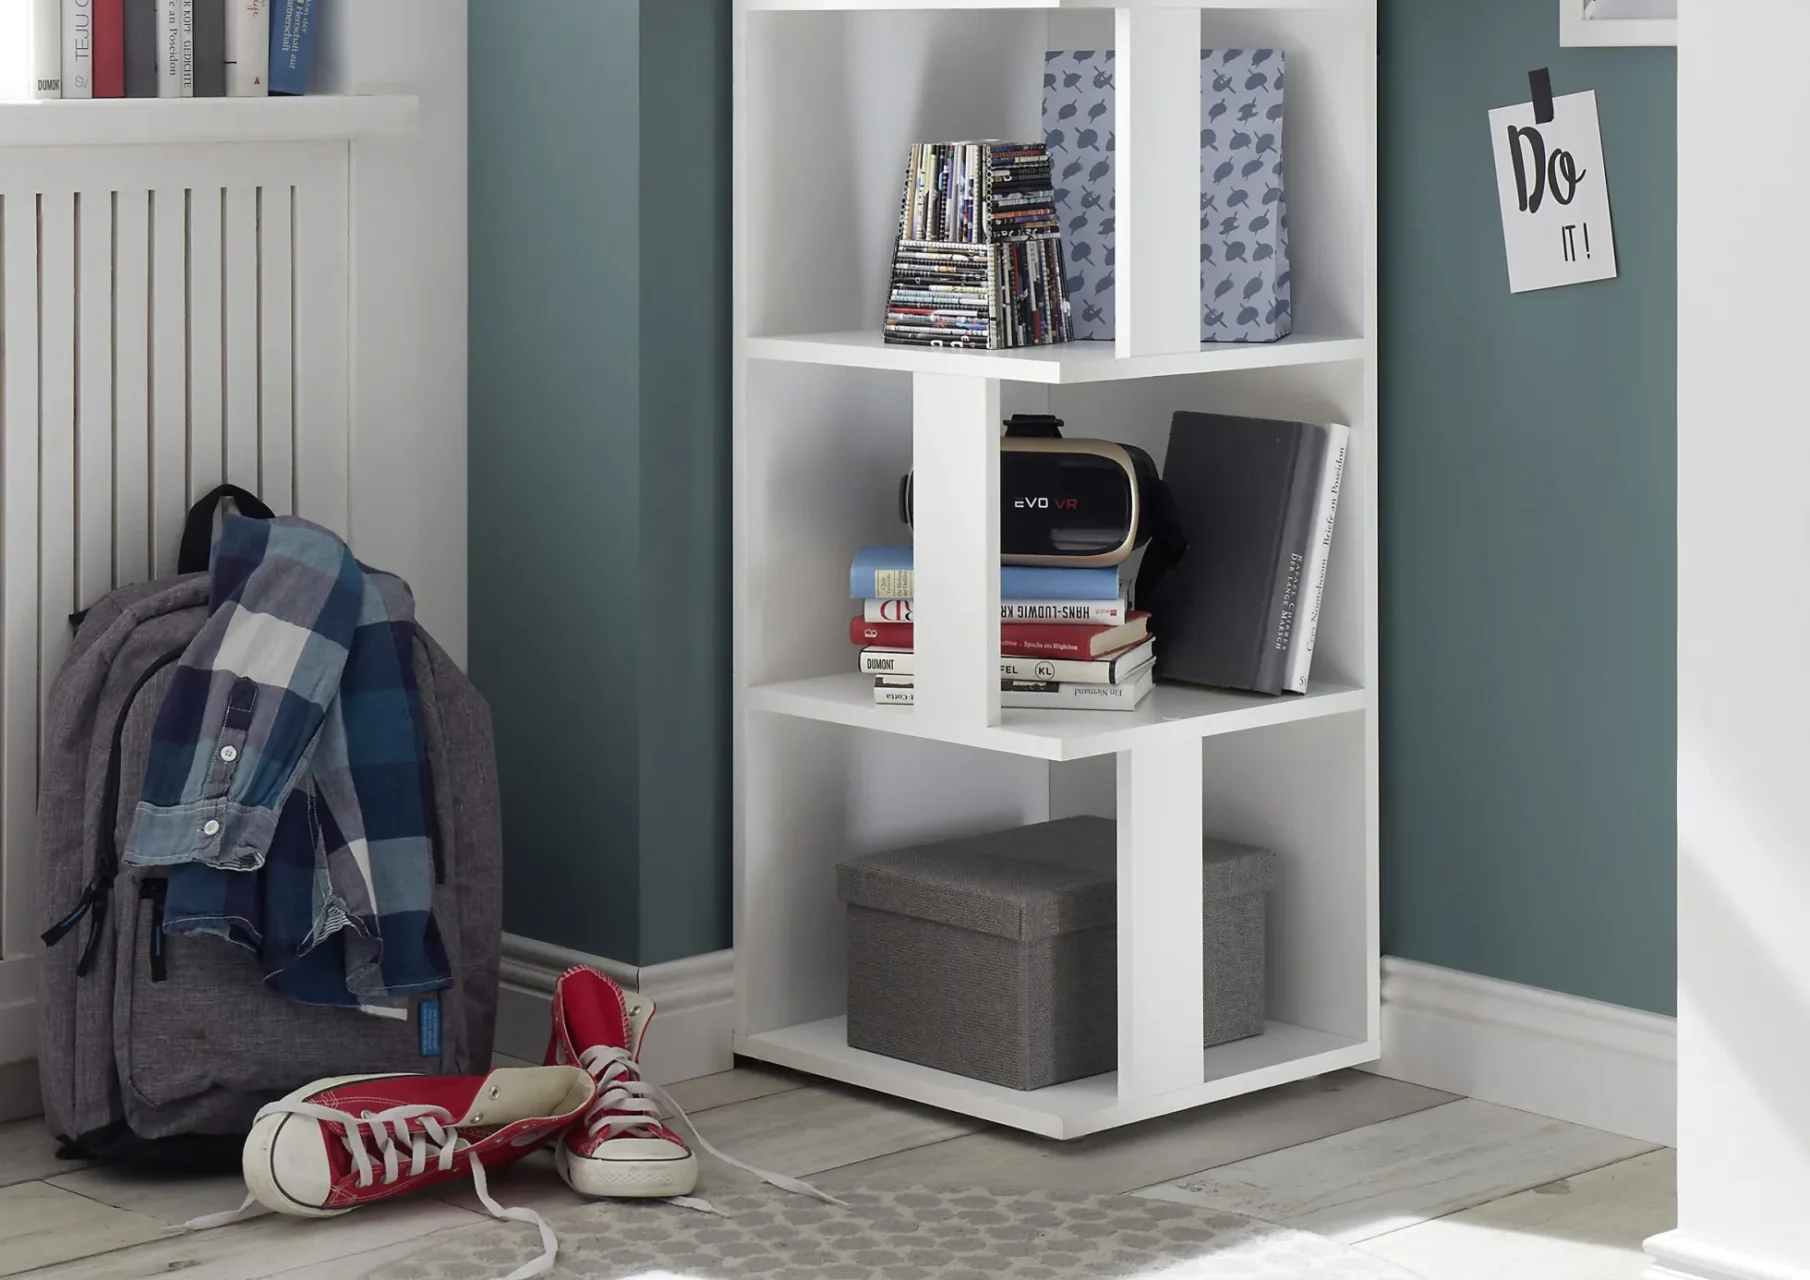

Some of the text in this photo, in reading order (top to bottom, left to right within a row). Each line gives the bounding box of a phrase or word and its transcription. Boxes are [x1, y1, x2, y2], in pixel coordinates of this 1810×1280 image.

[168, 10, 175, 24] an
[183, 10, 192, 34] KOPF
[75, 14, 89, 62] TEJU
[169, 28, 178, 76] Poseidon
[183, 40, 192, 89] GEDICHTE
[1507, 125, 1587, 214] Do
[1330, 447, 1345, 494] Poseidon
[1054, 499, 1078, 510] VR
[1291, 554, 1303, 597] RAFAEL
[1017, 605, 1090, 619] HANS-LUDWIG
[1024, 640, 1043, 649] Sprache
[867, 658, 895, 671] DUMONT
[1038, 667, 1052, 676] KL
[1074, 687, 1123, 697] Ein Niemand
